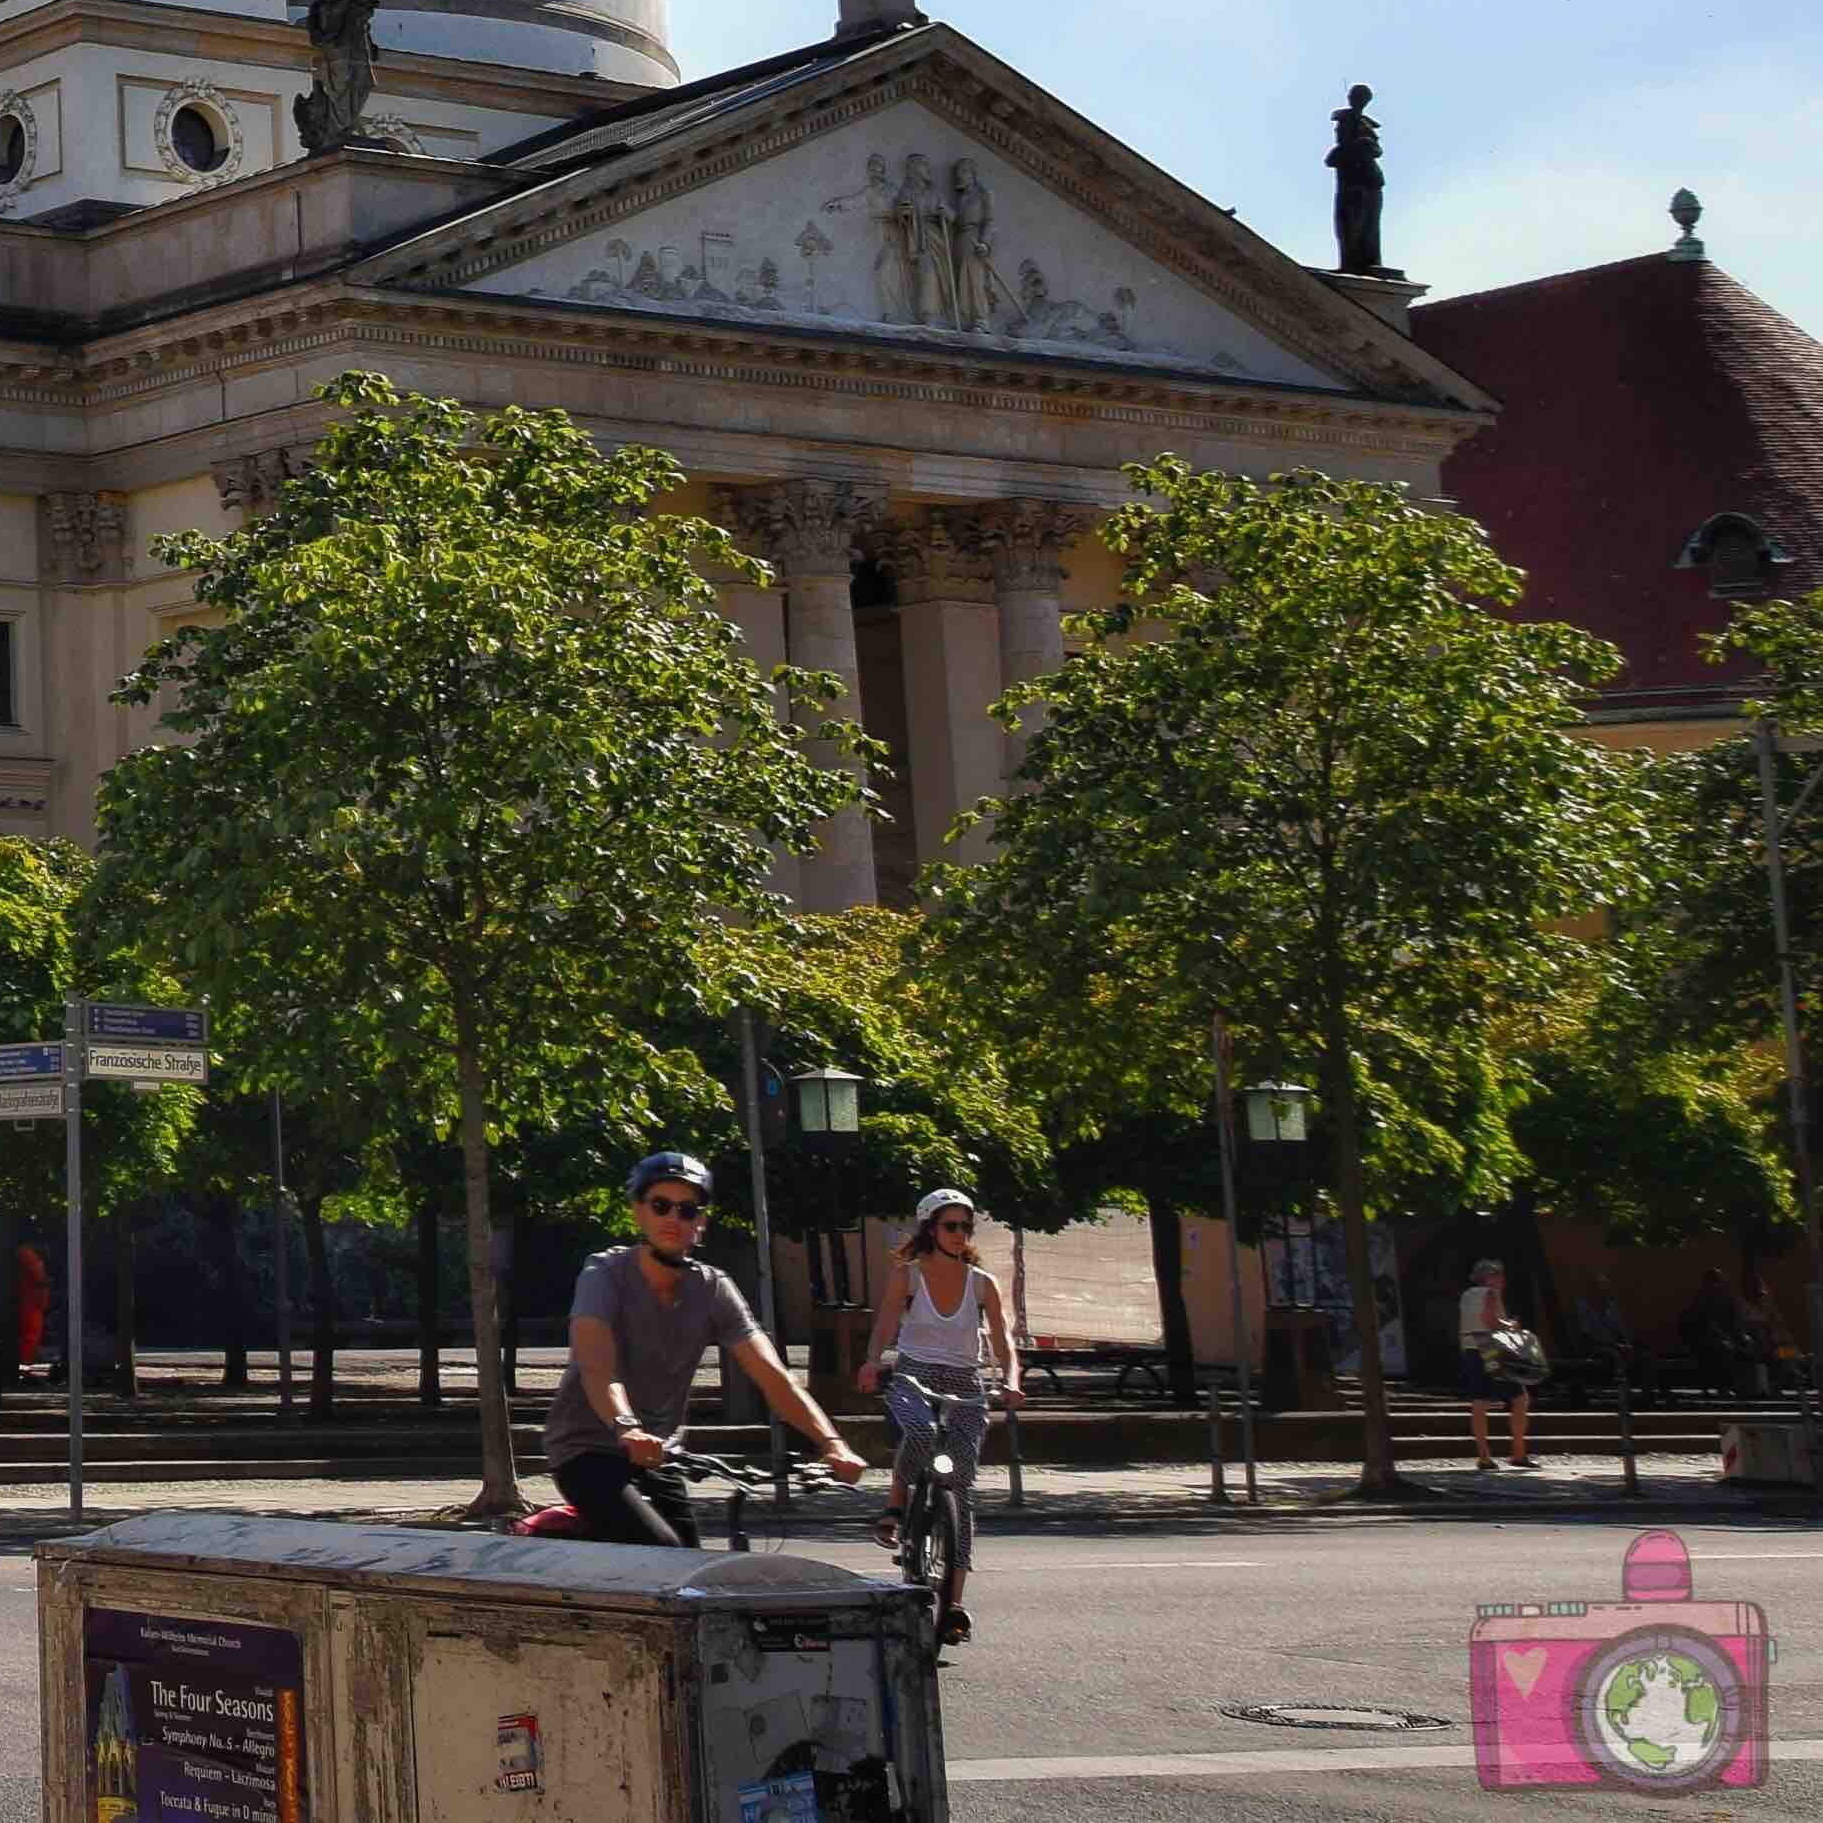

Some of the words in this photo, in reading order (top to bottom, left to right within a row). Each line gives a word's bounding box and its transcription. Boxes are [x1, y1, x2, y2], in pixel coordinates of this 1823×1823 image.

[89, 1049, 162, 1071] Französische
[165, 1053, 202, 1075] Straße
[151, 1681, 178, 1707] The
[180, 1685, 211, 1713] Four
[215, 1690, 274, 1721] Seasons
[162, 1727, 207, 1751] Symphony
[226, 1737, 233, 1751] 5
[242, 1738, 275, 1761] Allegro
[184, 1761, 222, 1782] Requiem
[231, 1770, 275, 1791] Lacrimosa
[159, 1791, 193, 1811] Toccata
[194, 1797, 202, 1812] &
[204, 1798, 229, 1819] Fugue
[231, 1803, 241, 1817] in
